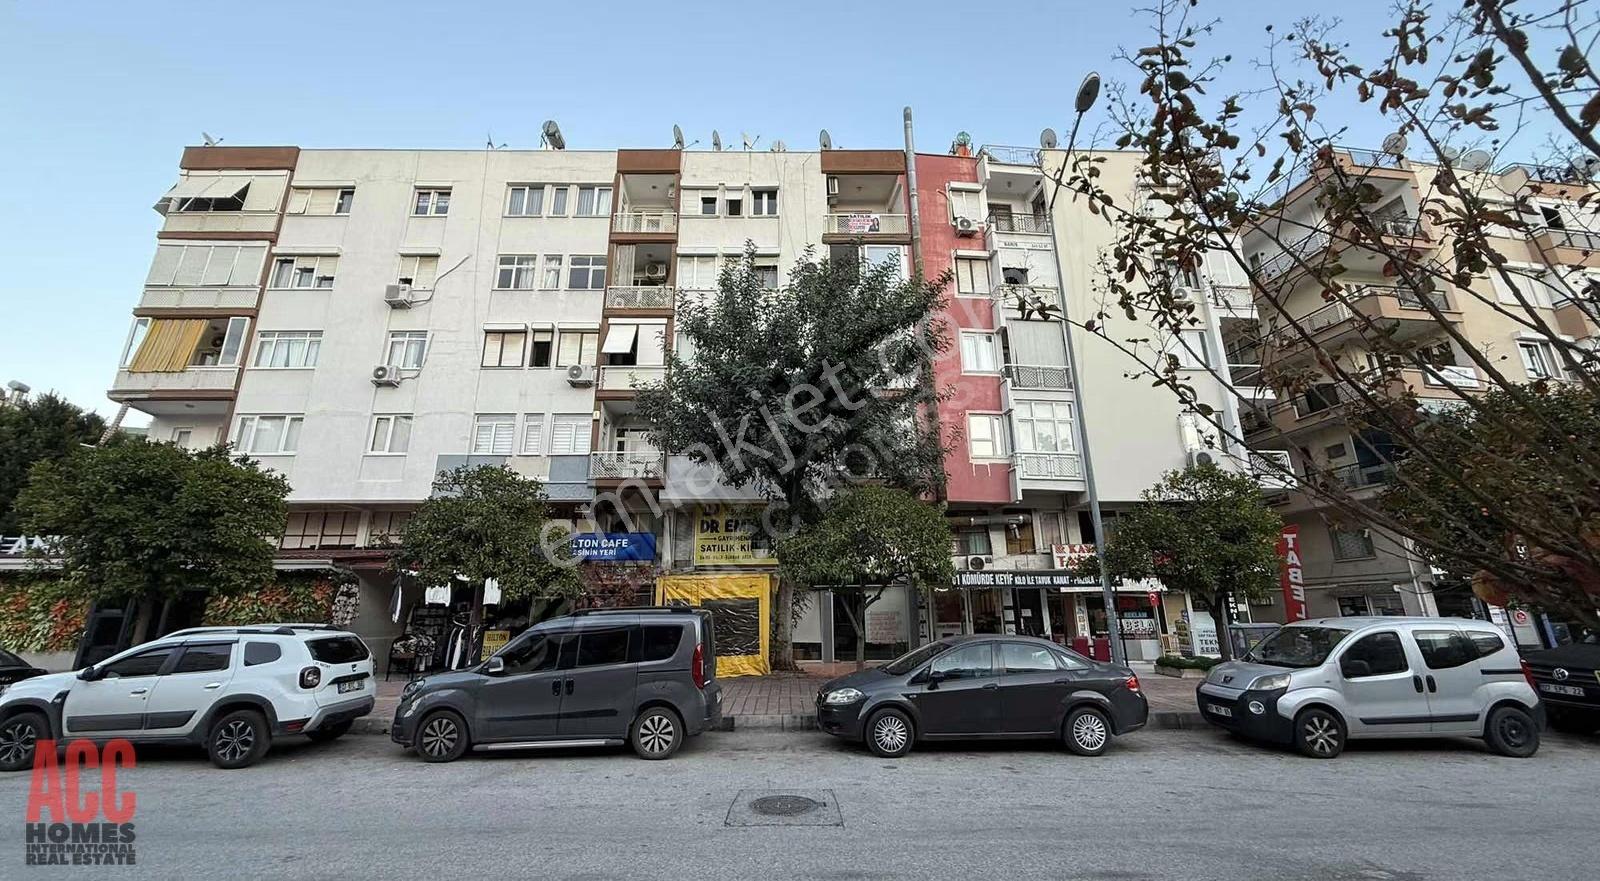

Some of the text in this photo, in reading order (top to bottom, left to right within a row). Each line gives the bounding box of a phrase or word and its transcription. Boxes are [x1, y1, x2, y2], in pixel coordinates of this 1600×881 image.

[700, 519, 720, 533] DR
[601, 539, 628, 548] CAFE
[573, 548, 616, 556] SİNİN YERİ
[961, 572, 994, 585] KÖMÜRDE
[995, 571, 1013, 585] KEYİF
[1035, 576, 1052, 585] TAVUK
[1053, 576, 1069, 584] KANAT
[1283, 533, 1306, 619] TABEL
